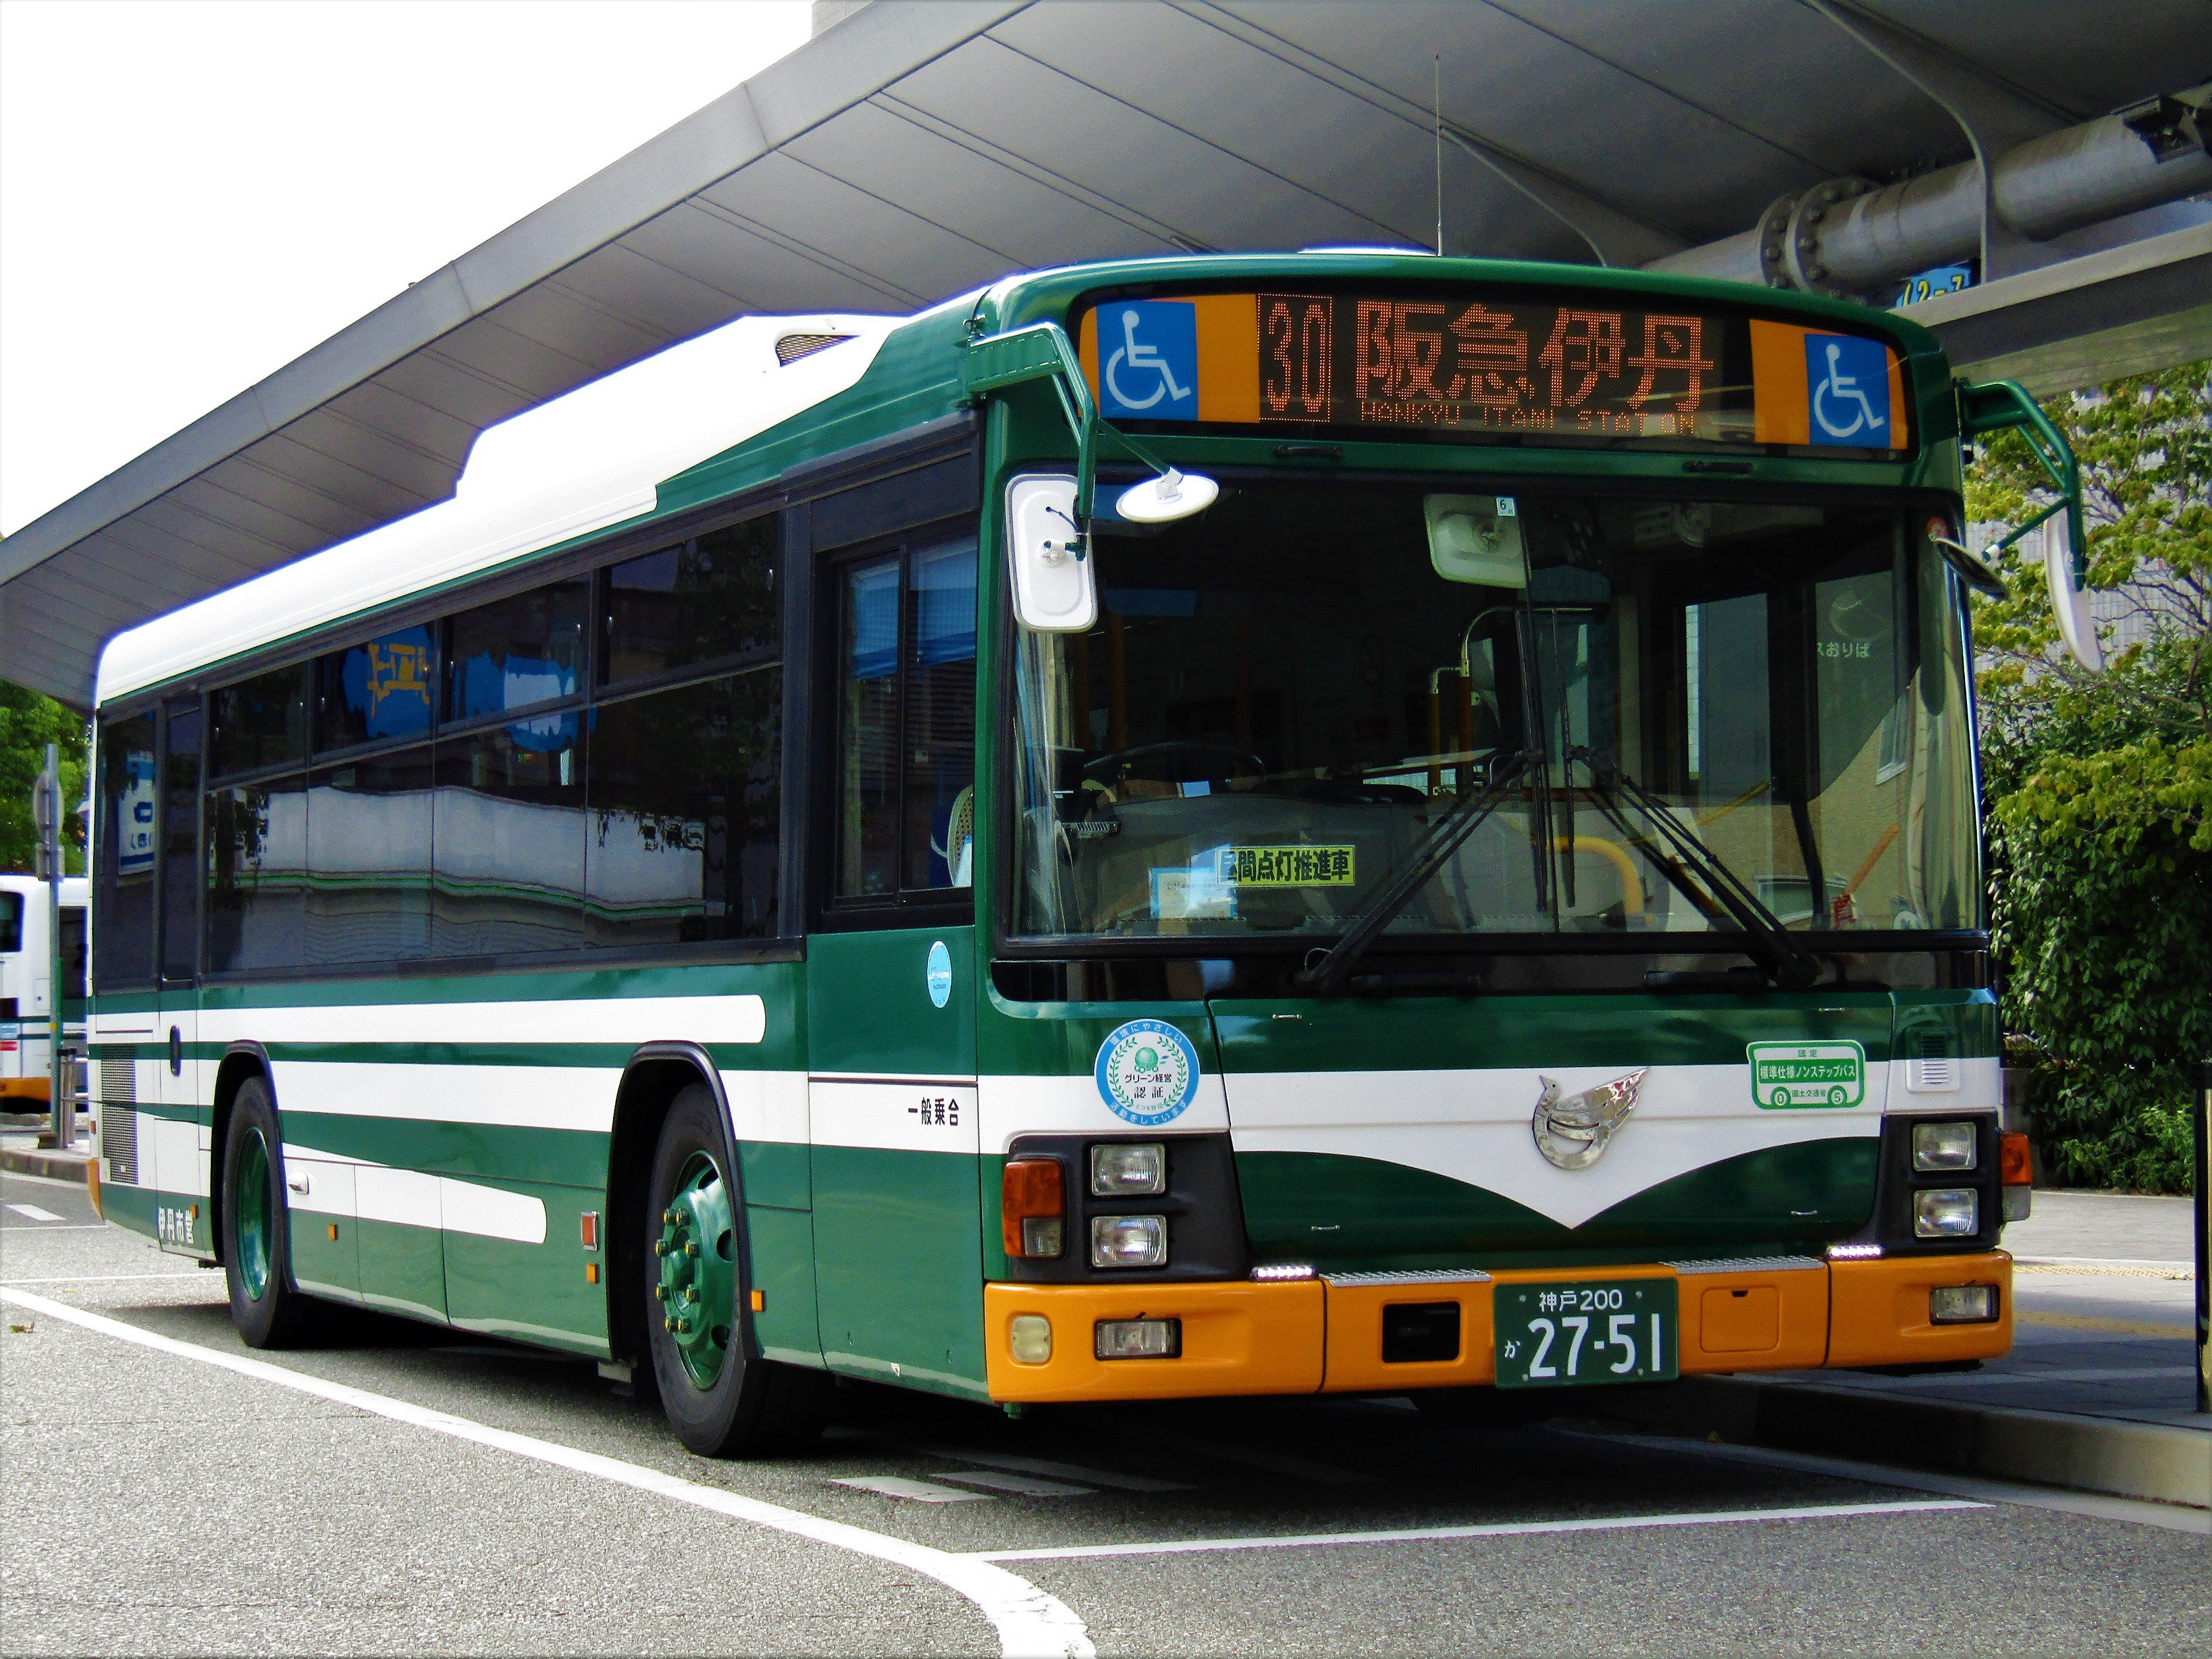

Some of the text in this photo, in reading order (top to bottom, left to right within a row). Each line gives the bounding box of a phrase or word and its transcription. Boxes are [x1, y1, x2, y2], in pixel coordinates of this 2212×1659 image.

[1267, 302, 1327, 413] 30
[1355, 300, 1714, 413] 阪急伊丹
[1361, 404, 1695, 435] HANKYU ITAMI STATON
[1499, 499, 1507, 510] 6
[1220, 849, 1350, 882] 昼間点灯推進車
[1124, 1074, 1172, 1084] グリーン経営
[1759, 1065, 1856, 1080] 標準仕様ノンステップバス
[907, 1097, 959, 1126] 一般乗合
[158, 1206, 194, 1244] 伊丹市営
[1504, 1313, 1662, 1377] か 27-51
